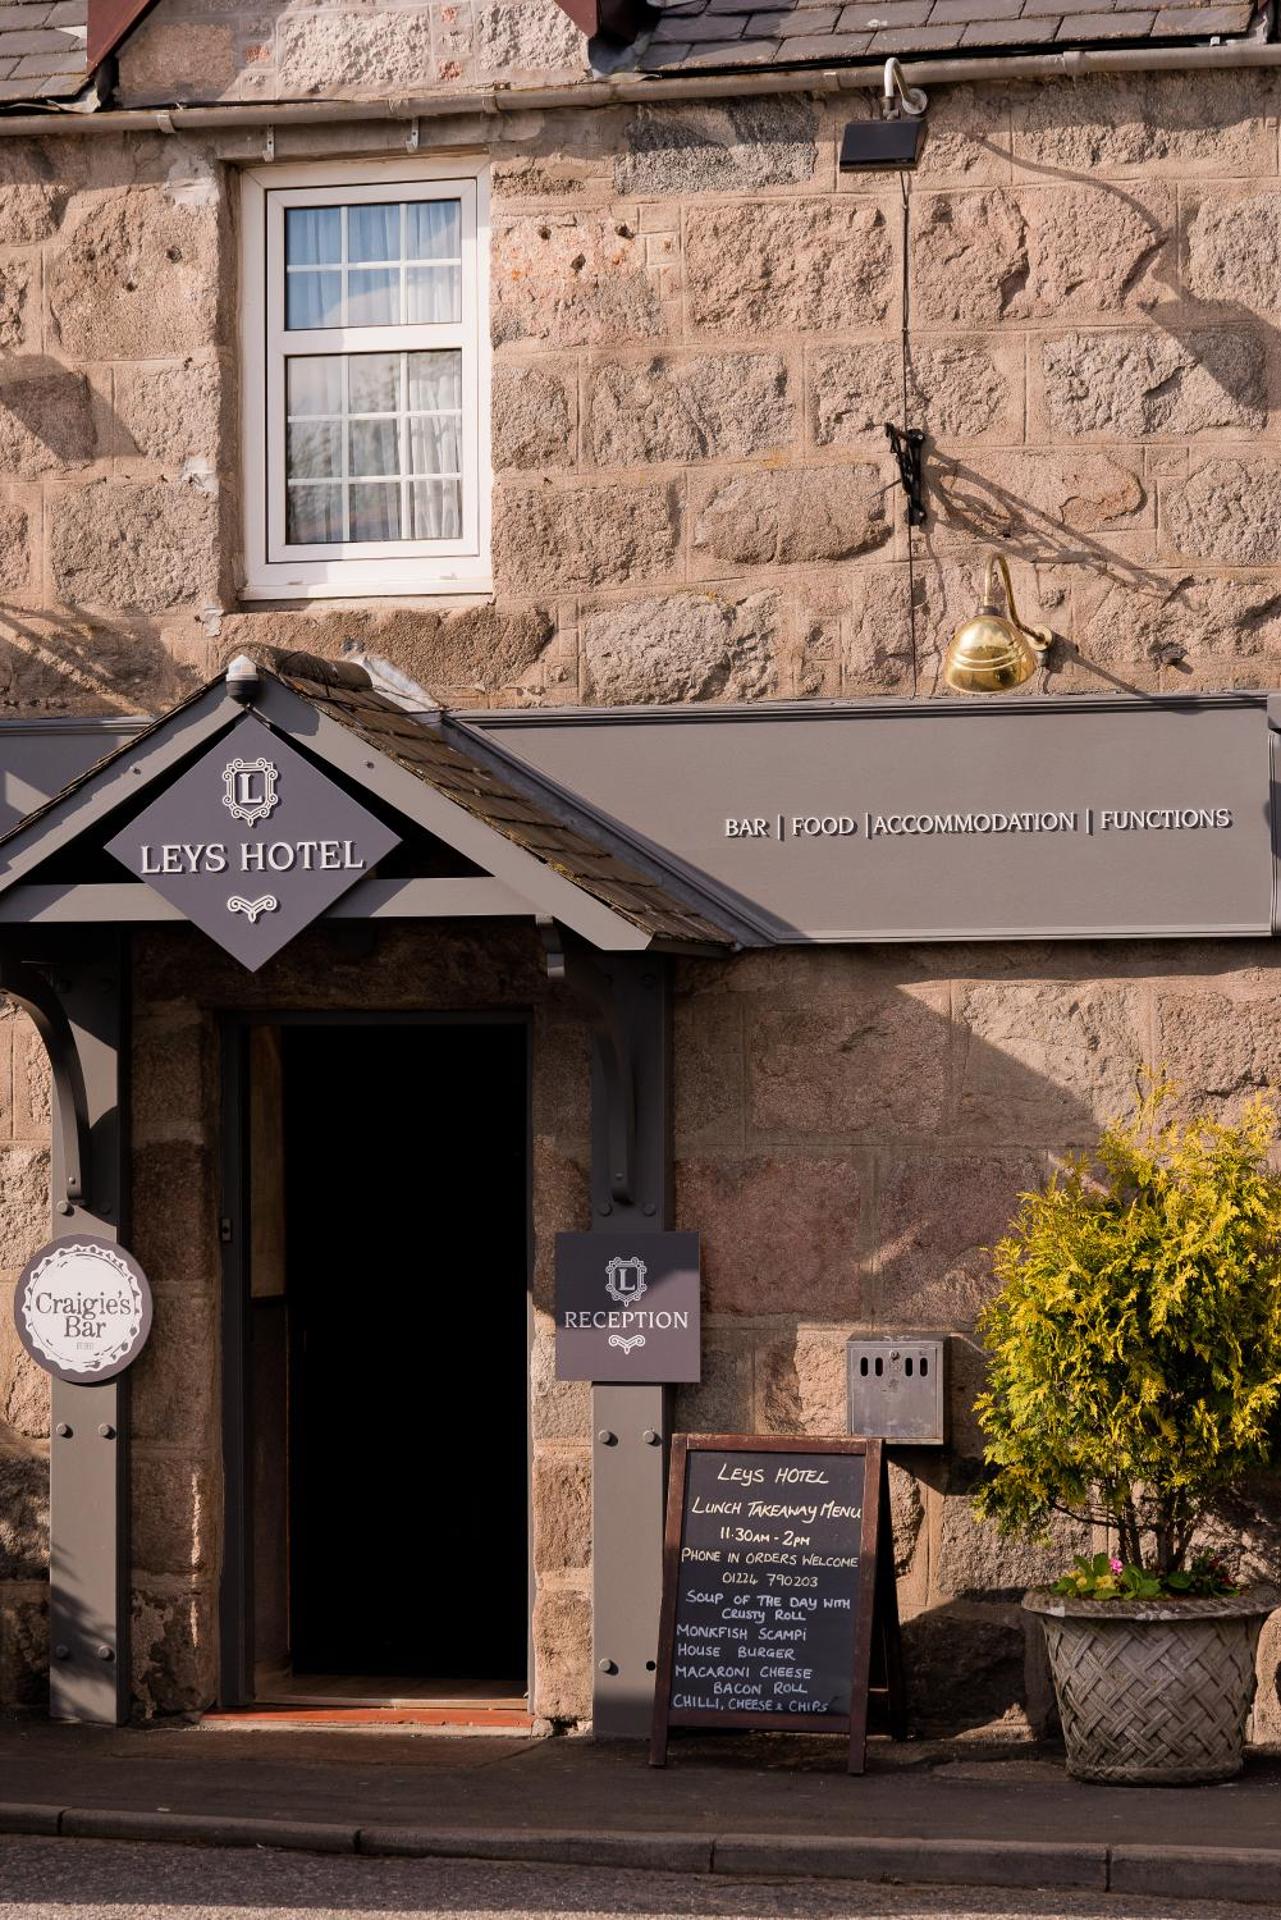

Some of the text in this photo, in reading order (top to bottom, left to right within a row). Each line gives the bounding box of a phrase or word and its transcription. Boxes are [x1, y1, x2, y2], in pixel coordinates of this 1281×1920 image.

[239, 772, 263, 804] L
[724, 808, 1231, 837] BAR FOOD ACCOMMODATION FUNCTIONS
[140, 840, 364, 874] LEYS HOTEL
[619, 1268, 636, 1291] L
[35, 1290, 132, 1320] Craigie's
[64, 1316, 107, 1338] Bar
[564, 1311, 689, 1329] RECEPTION
[775, 1467, 829, 1485] HOTEL
[691, 1496, 862, 1524] LUNCH TAKEAWAY MENU
[782, 1530, 811, 1546] 2PM
[681, 1547, 858, 1568] PHONE IN ORDERS WELCOME
[722, 1571, 818, 1587] 01224 790203
[685, 1589, 851, 1611] SOUP OF THE DAY WITH
[721, 1608, 807, 1624] CRUSTY ROLL
[676, 1624, 748, 1640] MONKFISH
[677, 1643, 796, 1660] HOUSE BURGER
[675, 1665, 813, 1679] MACARONI CHEESE
[713, 1681, 808, 1695] BACON ROLL
[728, 1698, 772, 1711] CHEESE
[789, 1700, 829, 1712] CHIPS
